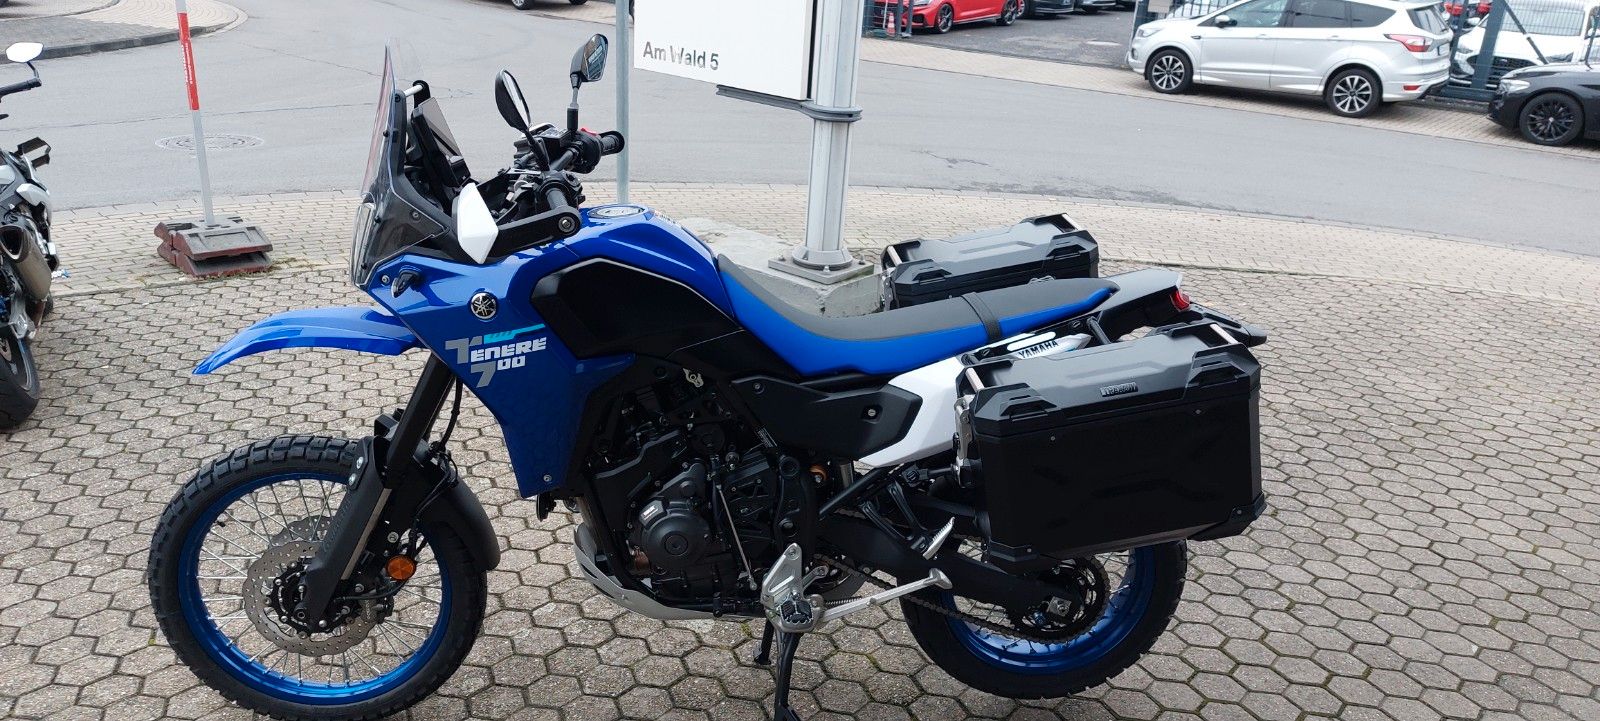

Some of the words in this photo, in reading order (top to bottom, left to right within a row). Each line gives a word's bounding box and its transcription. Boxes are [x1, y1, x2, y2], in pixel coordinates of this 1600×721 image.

[643, 41, 666, 61] Am
[670, 45, 706, 69] Wald
[710, 53, 719, 70] 5
[1018, 340, 1058, 359] YAMAHA
[471, 355, 526, 388] 700
